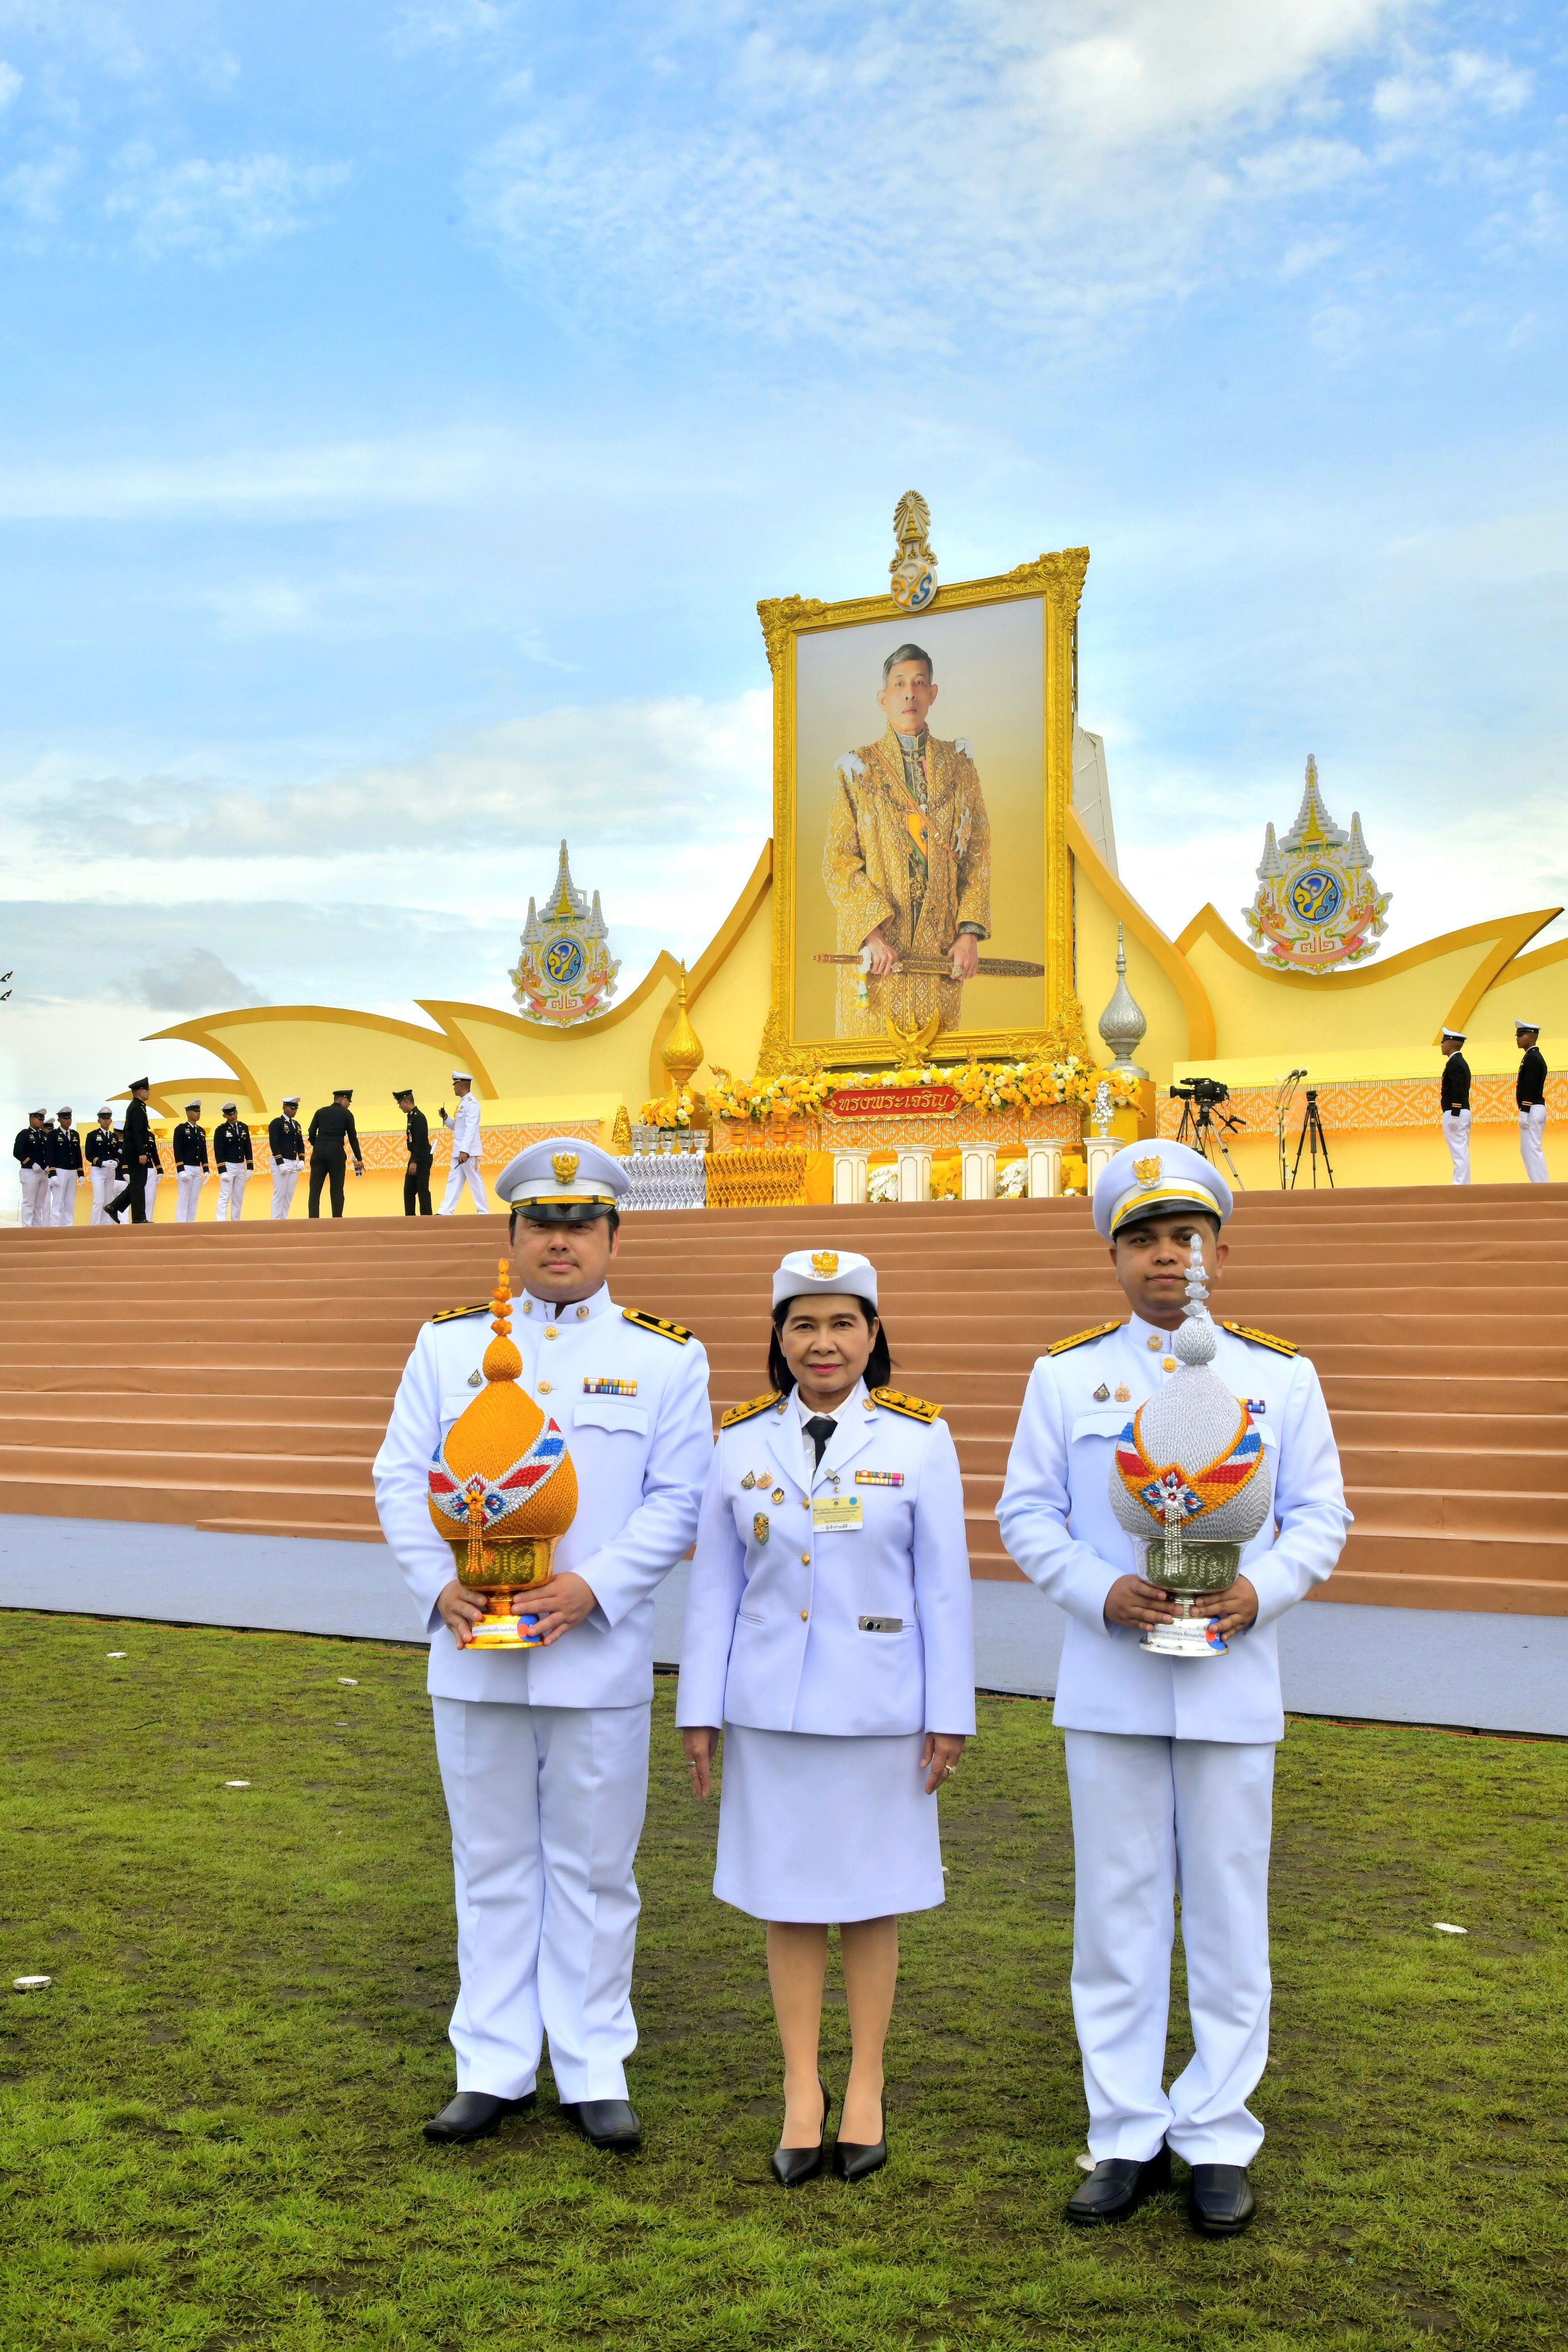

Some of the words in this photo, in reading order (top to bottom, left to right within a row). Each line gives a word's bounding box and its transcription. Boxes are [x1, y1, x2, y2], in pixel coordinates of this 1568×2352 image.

[838, 1090, 950, 1111] ทรงพระเจริญ
